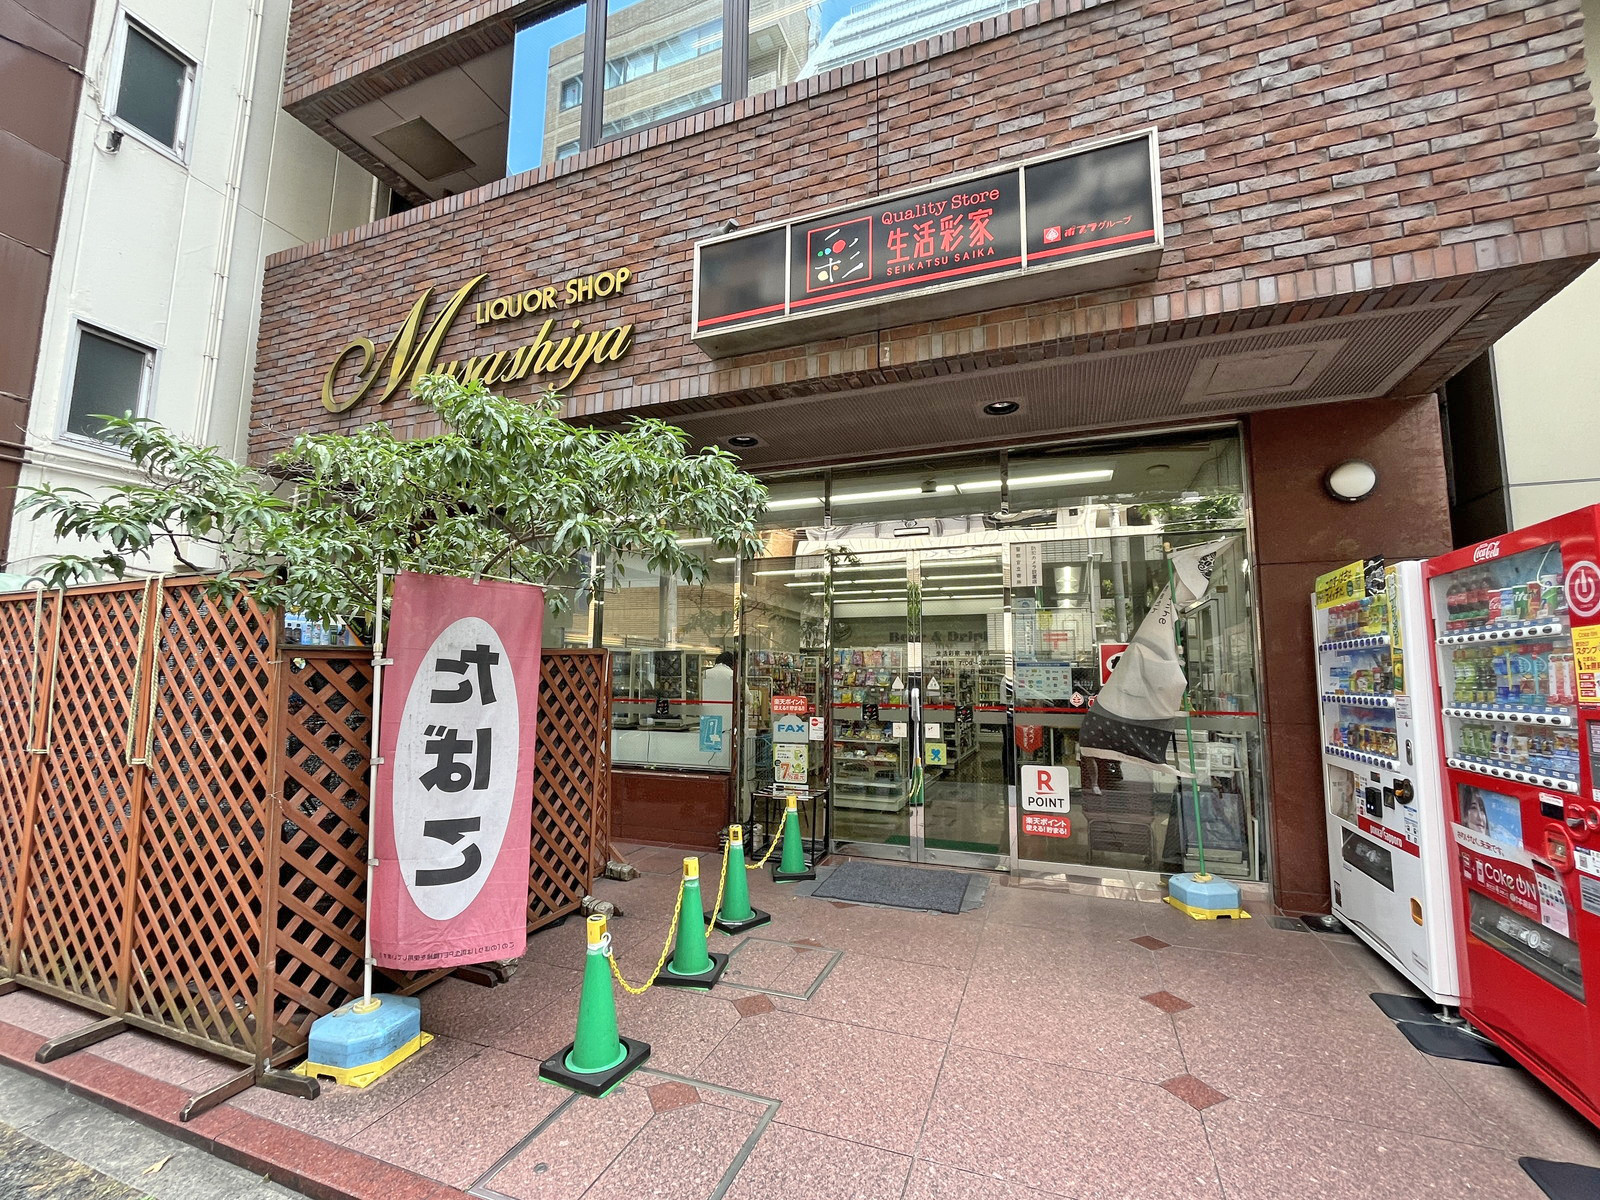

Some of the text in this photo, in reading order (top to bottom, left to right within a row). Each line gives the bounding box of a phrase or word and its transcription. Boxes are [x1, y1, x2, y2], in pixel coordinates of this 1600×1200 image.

[881, 189, 1000, 225] Quality Store
[887, 208, 994, 265] 生活彩家
[887, 246, 995, 276] SEIKATSU SAIKA
[476, 266, 634, 326] LIQUOR SHOP
[1473, 541, 1500, 562] Coca-Cola
[777, 724, 805, 732] FAX
[1037, 770, 1055, 791] R
[1028, 796, 1065, 808] POINT
[1025, 816, 1067, 827] 楽天ポイント
[1484, 862, 1515, 890] Coke
